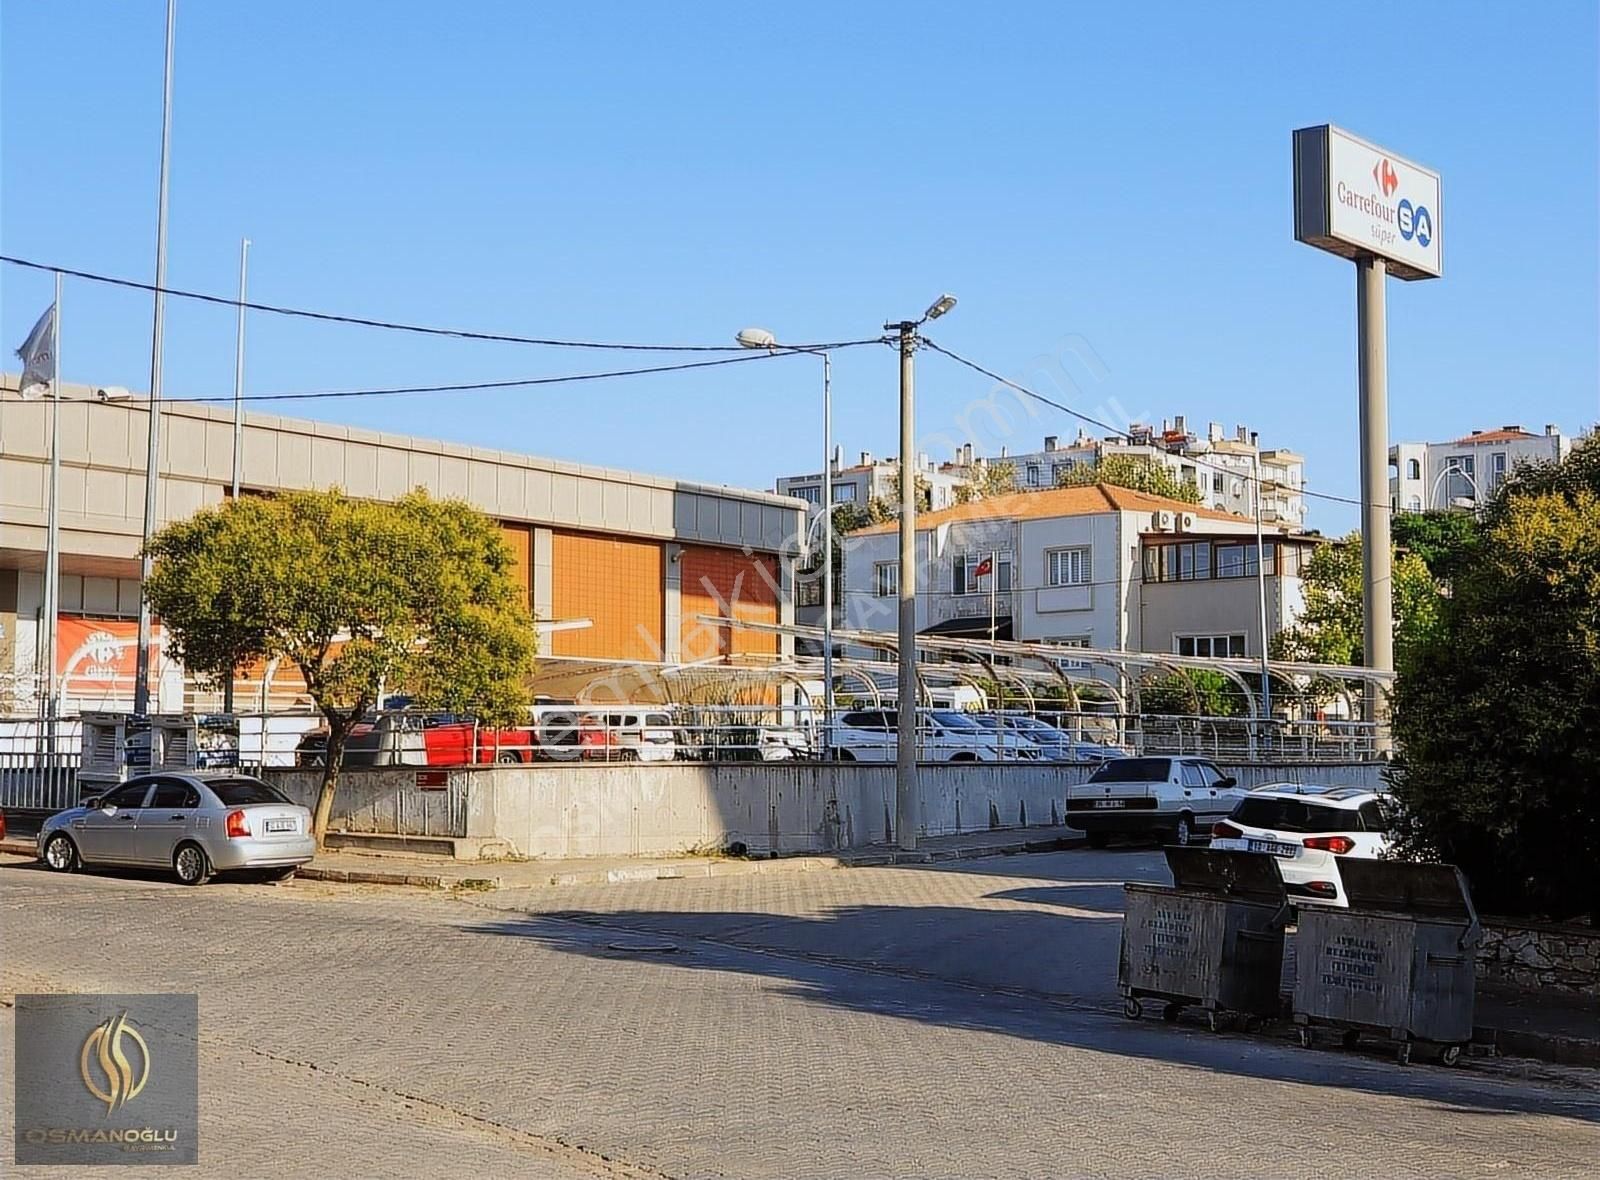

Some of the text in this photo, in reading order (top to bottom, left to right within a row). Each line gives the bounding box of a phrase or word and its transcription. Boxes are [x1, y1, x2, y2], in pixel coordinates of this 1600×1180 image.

[1337, 181, 1396, 224] Carrefour
[1371, 224, 1396, 246] süper
[1398, 203, 1431, 244] SA
